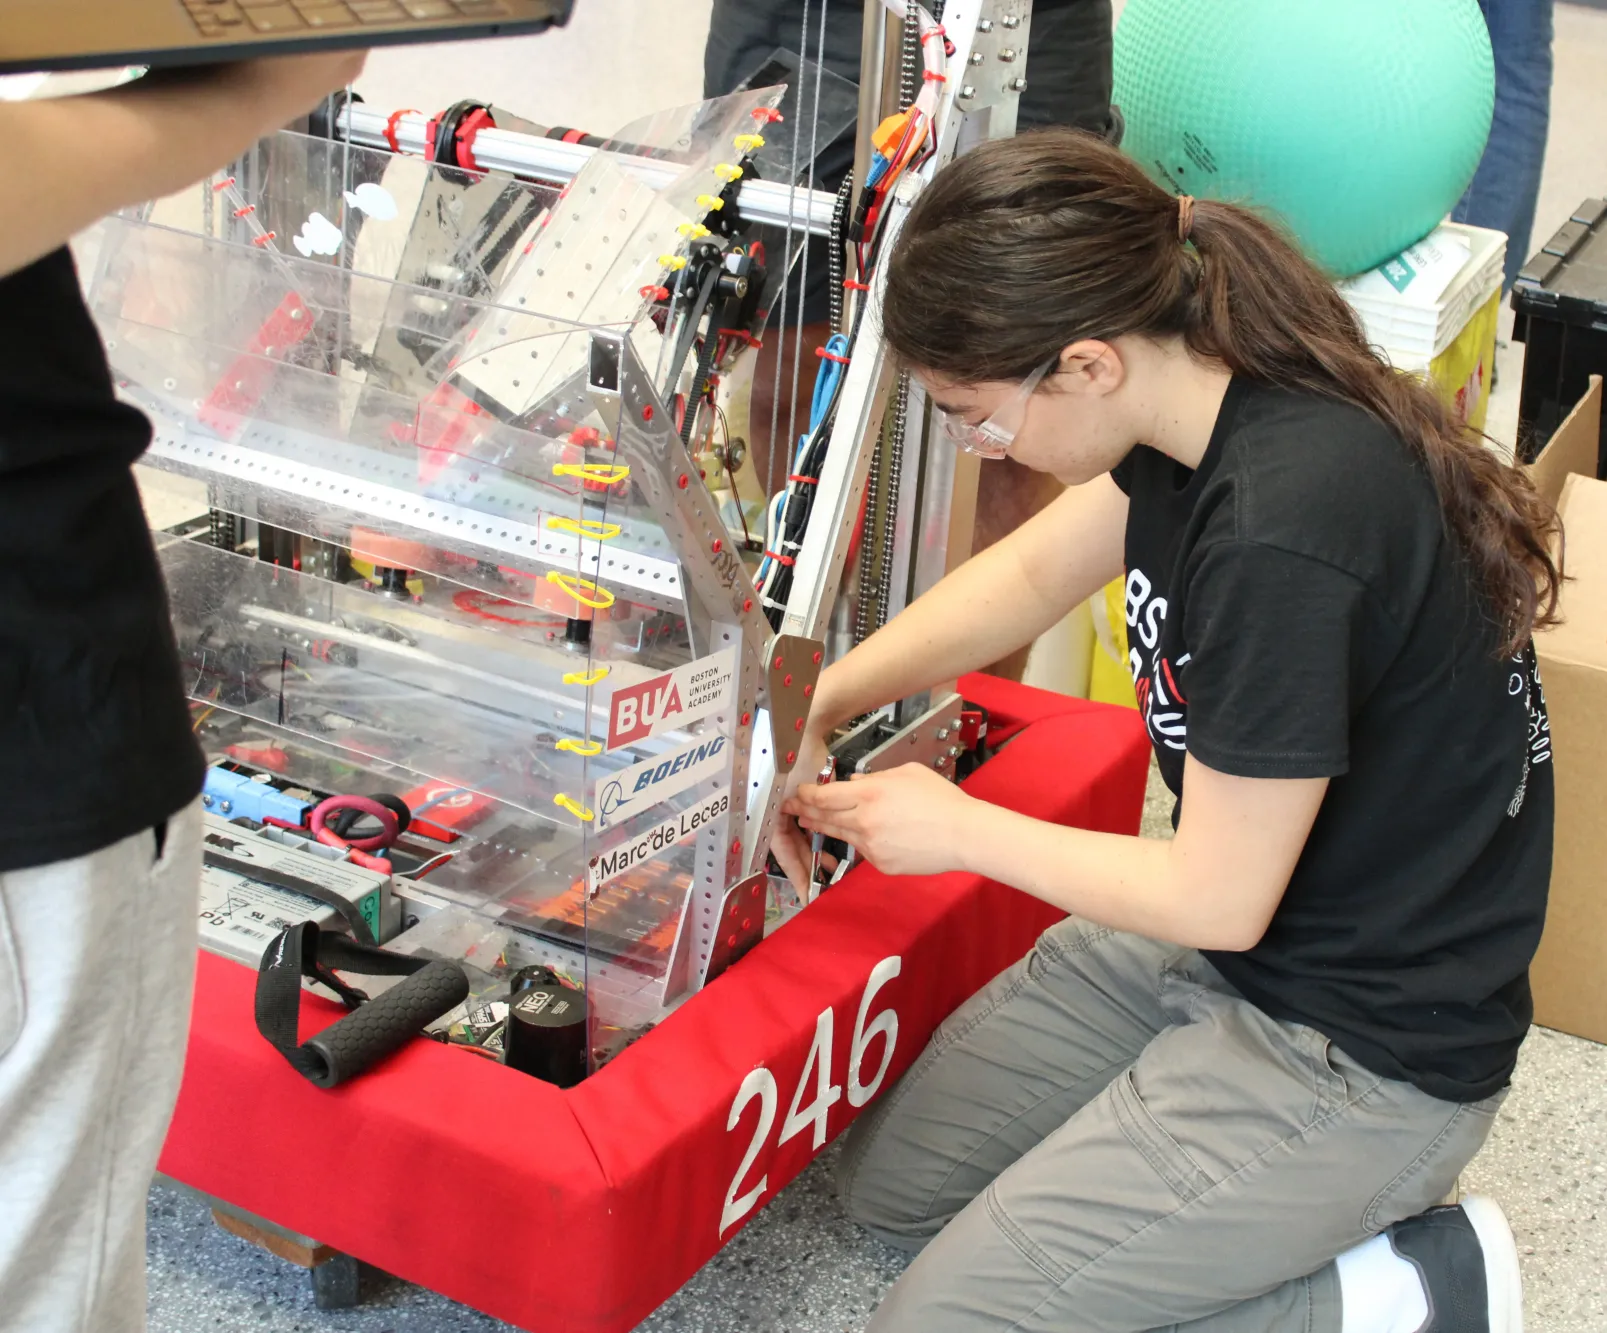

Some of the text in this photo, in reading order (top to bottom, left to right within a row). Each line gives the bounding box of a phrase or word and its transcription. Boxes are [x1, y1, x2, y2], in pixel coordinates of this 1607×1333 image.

[689, 673, 732, 697] UNIVERSITY
[690, 666, 718, 684] BOSTON
[616, 683, 682, 736] BUA
[687, 688, 722, 709] ACADEMY
[632, 736, 725, 793] BOEING
[601, 795, 729, 880] Marc de Lecea
[520, 991, 549, 1014] NEO
[718, 955, 902, 1241] 246
